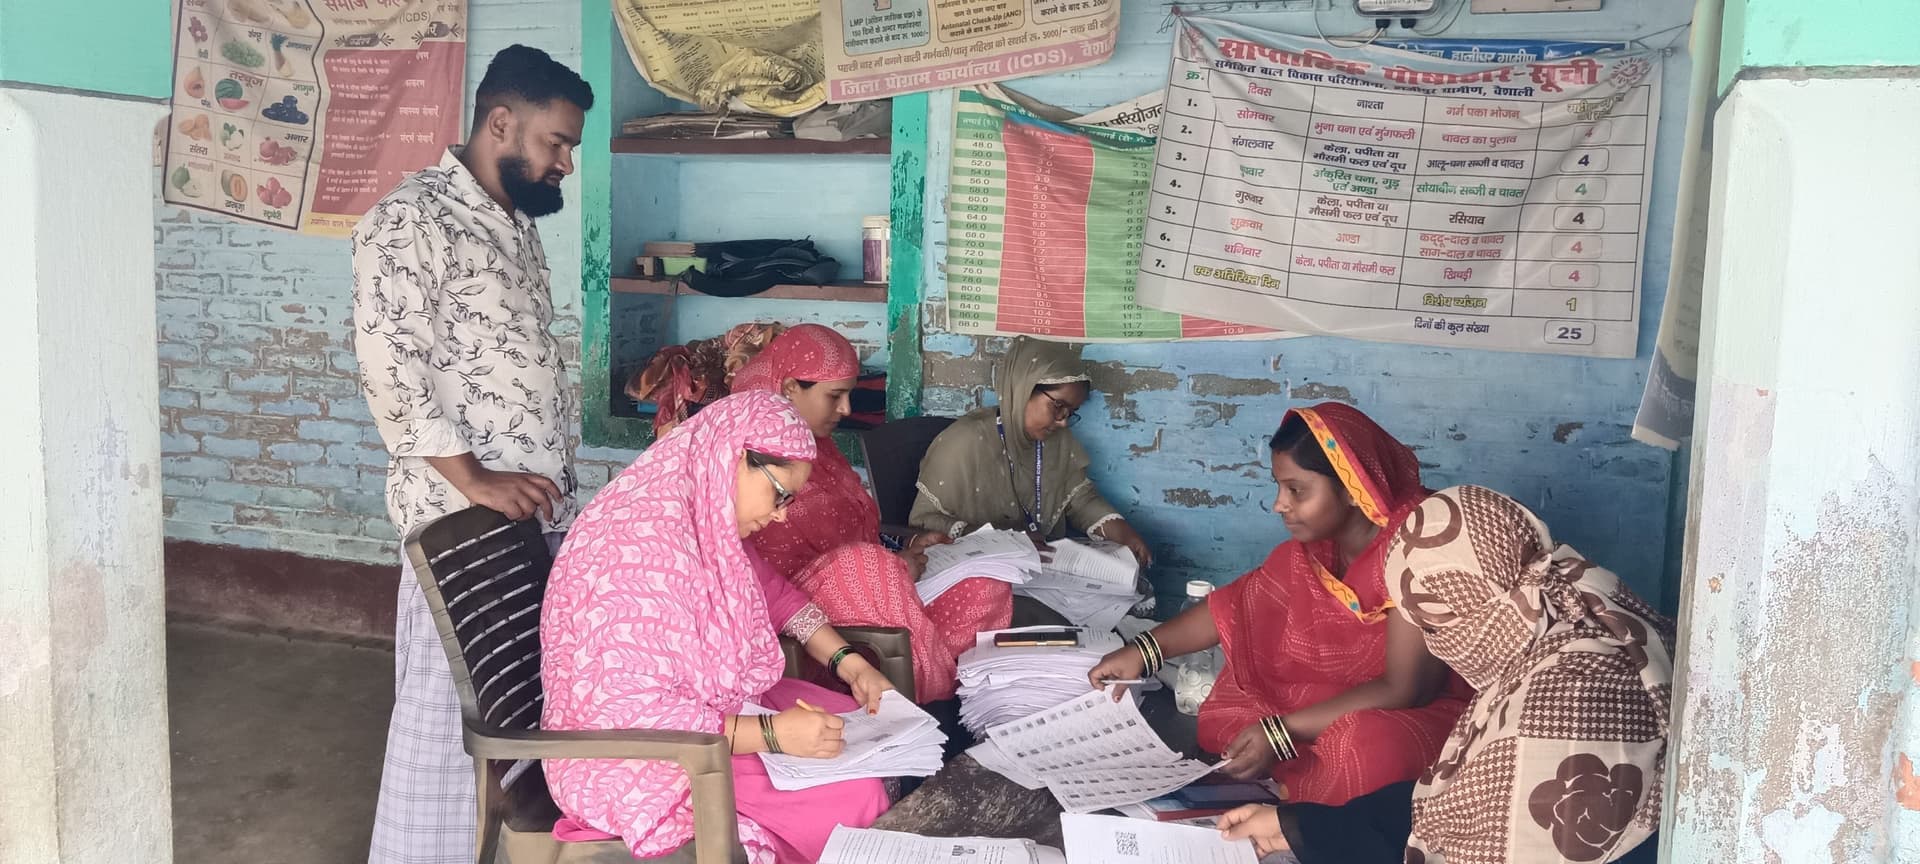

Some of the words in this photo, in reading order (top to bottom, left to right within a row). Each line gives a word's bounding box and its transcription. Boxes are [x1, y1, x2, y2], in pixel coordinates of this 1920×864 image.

[840, 80, 880, 96] जिला
[884, 72, 931, 90] प्रोग्राम
[936, 60, 1001, 81] कार्यालय
[1260, 66, 1282, 76] बाल
[1288, 68, 1322, 82] विकास
[1248, 82, 1272, 96] दिवस
[1187, 98, 1198, 107] 1.
[1356, 99, 1384, 110] नाश्ता
[1237, 108, 1275, 122] सोमवार
[1446, 104, 1464, 117] गर्म
[1467, 108, 1488, 118] पका
[1490, 106, 1520, 120] भोजन
[1180, 125, 1192, 134] 2.
[1314, 122, 1334, 134] भुना
[1358, 125, 1374, 136] एवं
[1232, 135, 1275, 150] मंगलवार
[1472, 136, 1488, 144] का
[1489, 135, 1517, 148] पुलाव
[1176, 152, 1186, 161] 3.
[1354, 147, 1384, 158] पपीता
[1349, 158, 1370, 167] फल
[1492, 160, 1498, 168] व
[1578, 154, 1590, 167] 4
[1169, 179, 1182, 188] 4.
[1350, 184, 1378, 195] अण्डा
[1416, 182, 1456, 194] सोयाबीन
[1460, 184, 1486, 196] सब्जी
[1488, 188, 1497, 196] व
[1575, 184, 1588, 196] 4
[1346, 198, 1374, 210] पपीता
[1377, 202, 1389, 211] या
[1165, 206, 1176, 216] 5.
[1342, 210, 1362, 220] फल
[1364, 212, 1382, 222] एवं
[1448, 212, 1486, 224] रसियाव
[1572, 212, 1585, 224] 4
[1160, 233, 1170, 242] 6.
[1336, 233, 1360, 244] अण्डा
[1472, 236, 1478, 244] व
[1224, 242, 1262, 258] शनिवार
[1571, 242, 1583, 254] 4
[1154, 258, 1166, 268] 7.
[1318, 257, 1340, 270] पपीता
[1341, 262, 1350, 270] या
[1380, 265, 1396, 276] फल
[1194, 265, 1213, 276] एक
[1214, 268, 1260, 286] अतिरिक्त
[1261, 274, 1280, 289] दिन
[1444, 268, 1472, 281] खिचड़ी
[1569, 270, 1580, 282] 4
[1423, 293, 1452, 307] विशेष
[1566, 298, 1577, 312] 1
[1414, 316, 1432, 329] दिनों
[1434, 319, 1446, 330] की
[1448, 322, 1464, 336] कुल
[1466, 322, 1489, 334] संख्या
[1557, 328, 1582, 340] 25
